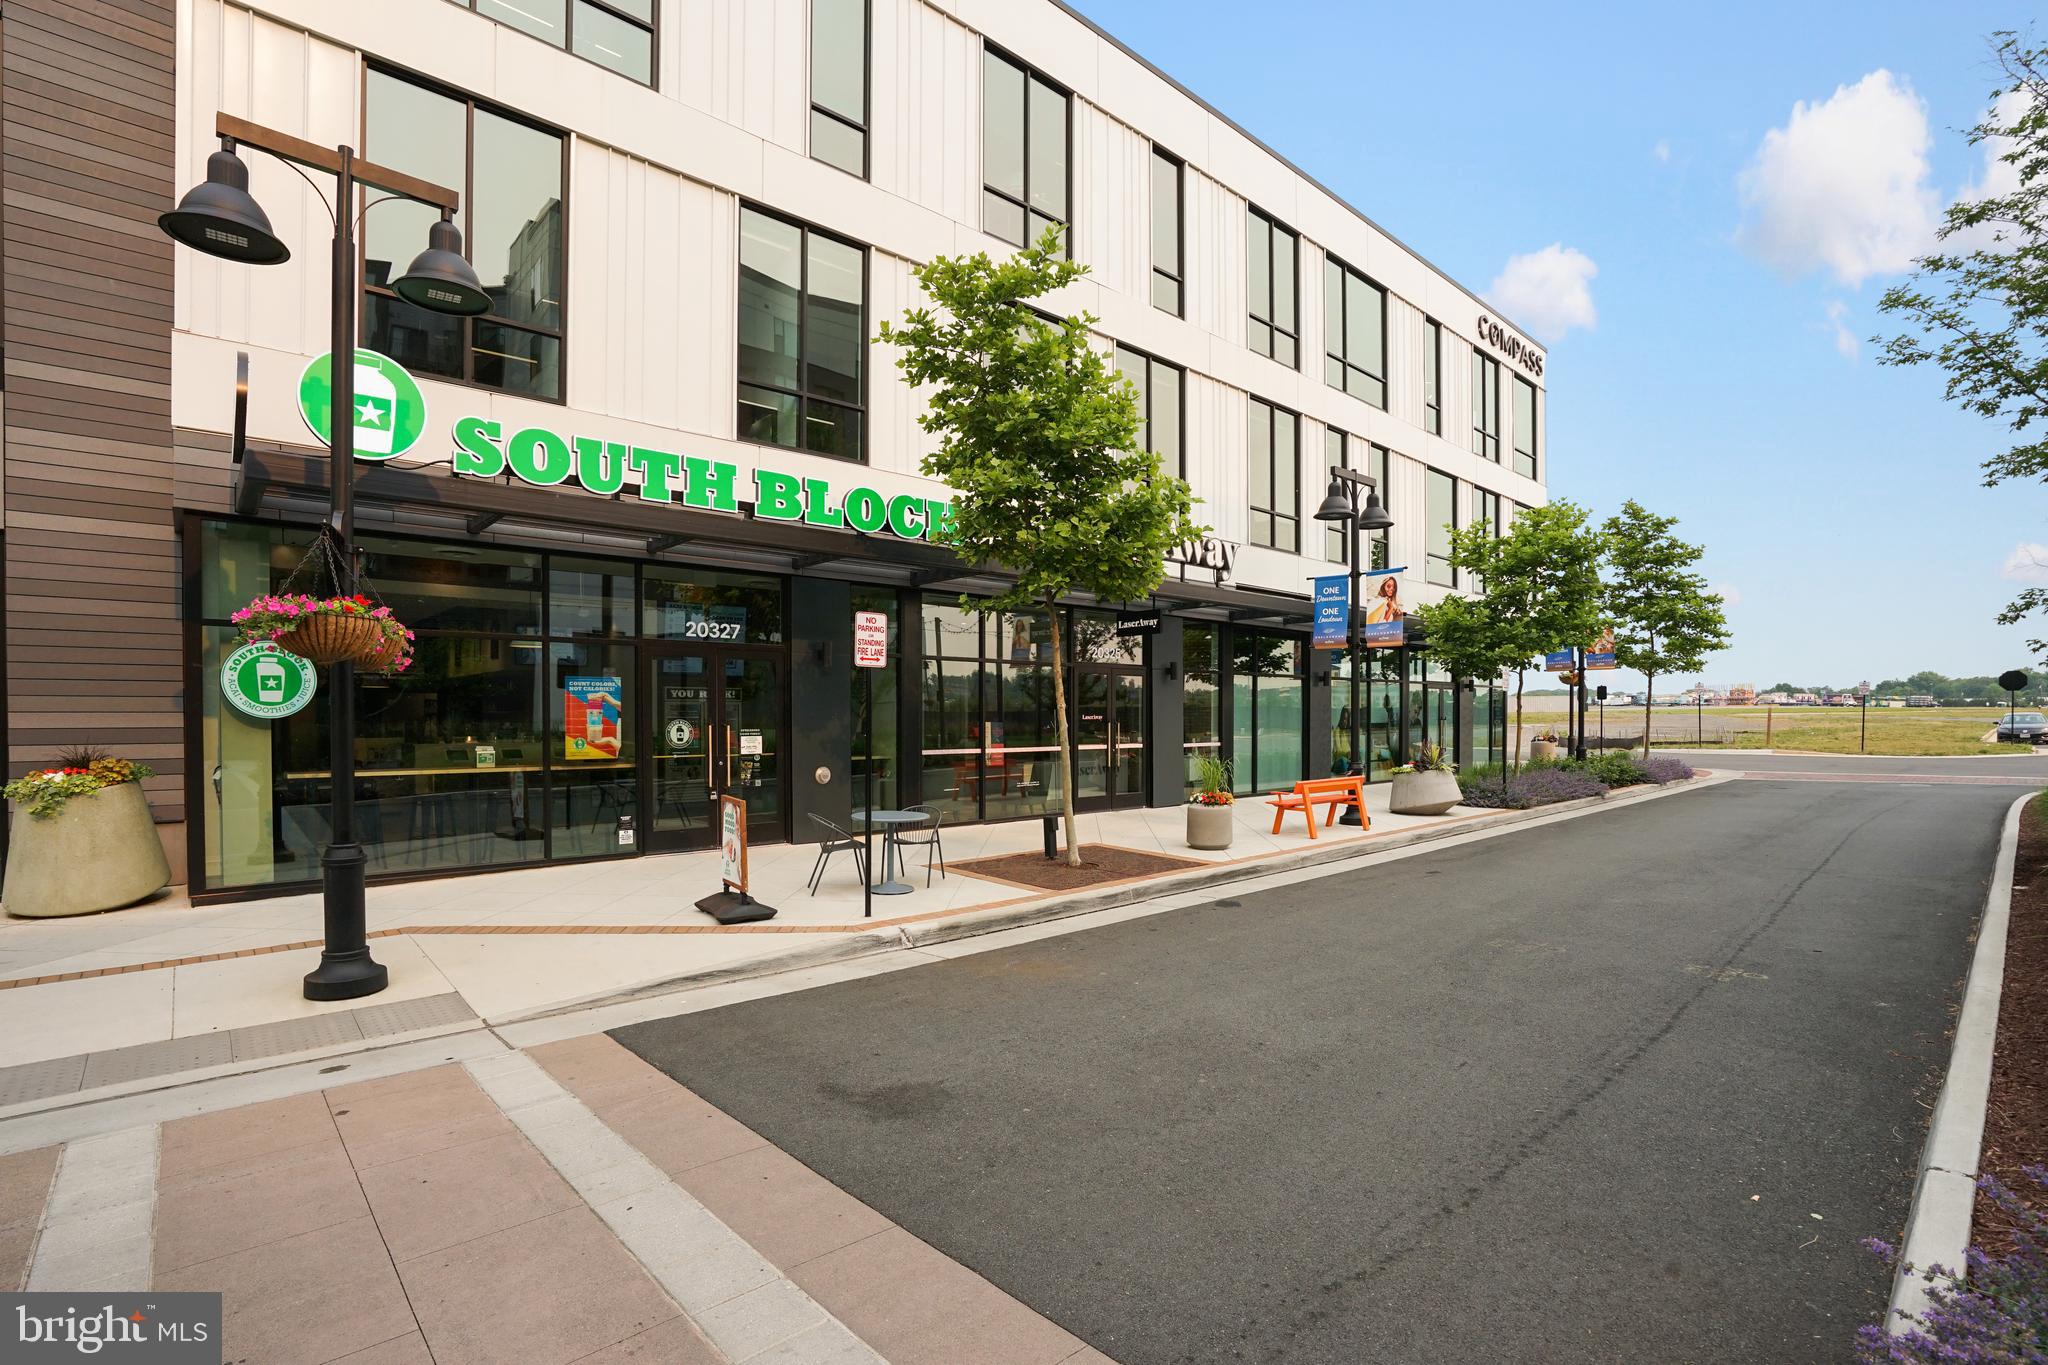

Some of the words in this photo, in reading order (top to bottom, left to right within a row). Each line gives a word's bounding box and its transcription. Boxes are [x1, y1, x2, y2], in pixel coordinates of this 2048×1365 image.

[1478, 315, 1543, 376] COMPASS
[452, 416, 738, 512] SOUTH
[1316, 594, 1346, 603] Downtown
[865, 617, 877, 625] NO
[1118, 619, 1159, 629] LaserAway
[685, 621, 741, 639] 20327
[857, 625, 885, 634] PARKING
[857, 638, 885, 648] STANDING
[857, 647, 869, 656] FIRE
[870, 648, 885, 657] LANE
[1092, 647, 1121, 659] 20325
[229, 645, 265, 673] SOUTH
[242, 700, 297, 714] SMOOTHIES
[297, 677, 311, 701] JUICE
[670, 689, 694, 698] YOU
